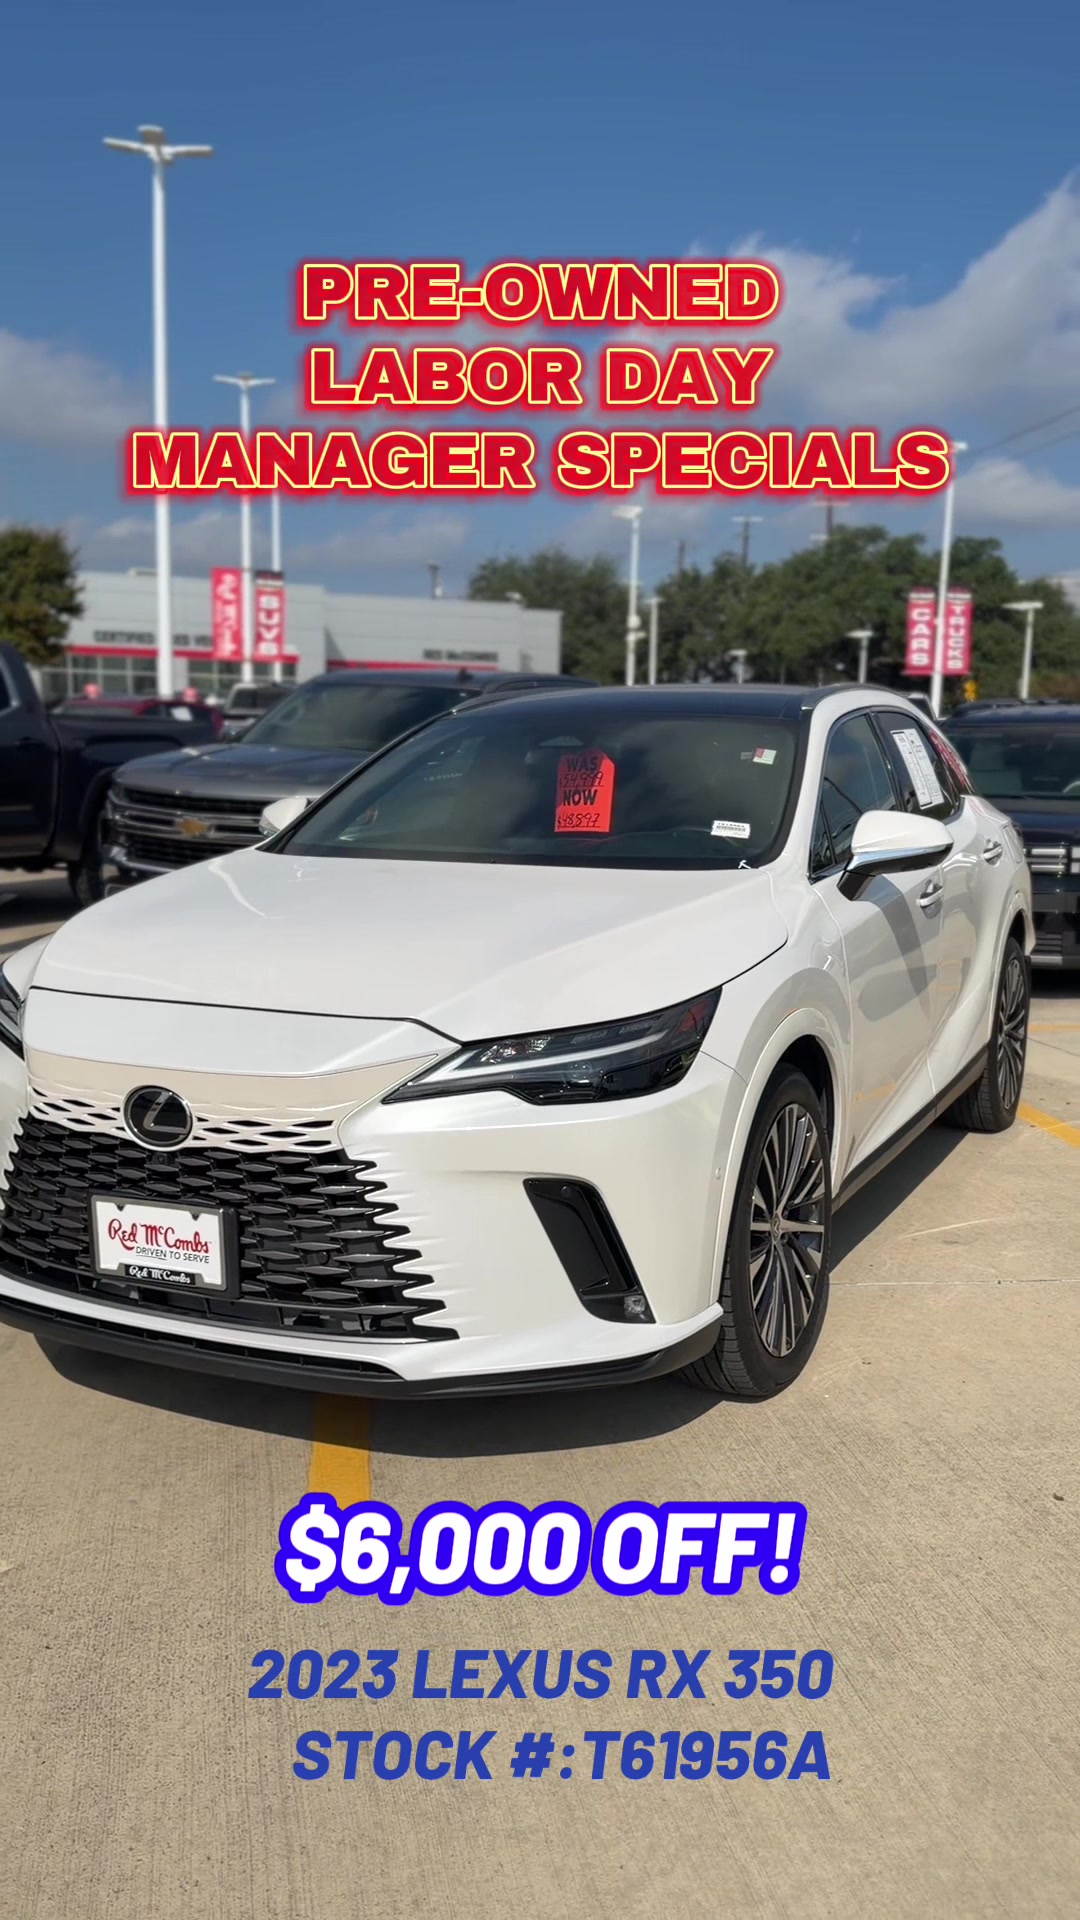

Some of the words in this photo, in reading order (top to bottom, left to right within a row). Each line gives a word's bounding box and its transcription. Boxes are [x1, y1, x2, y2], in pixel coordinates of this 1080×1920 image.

[911, 607, 932, 667] CARS
[946, 605, 966, 669] TRUCKS
[567, 756, 599, 772] WAS
[563, 789, 598, 806] NOW
[108, 1218, 138, 1251] Red
[140, 1223, 209, 1254] McCombs
[135, 1246, 167, 1259] DRIVEN
[169, 1251, 181, 1260] TO
[182, 1252, 210, 1264] SERVE
[129, 1265, 148, 1278] Red
[149, 1268, 191, 1284] McCombs
